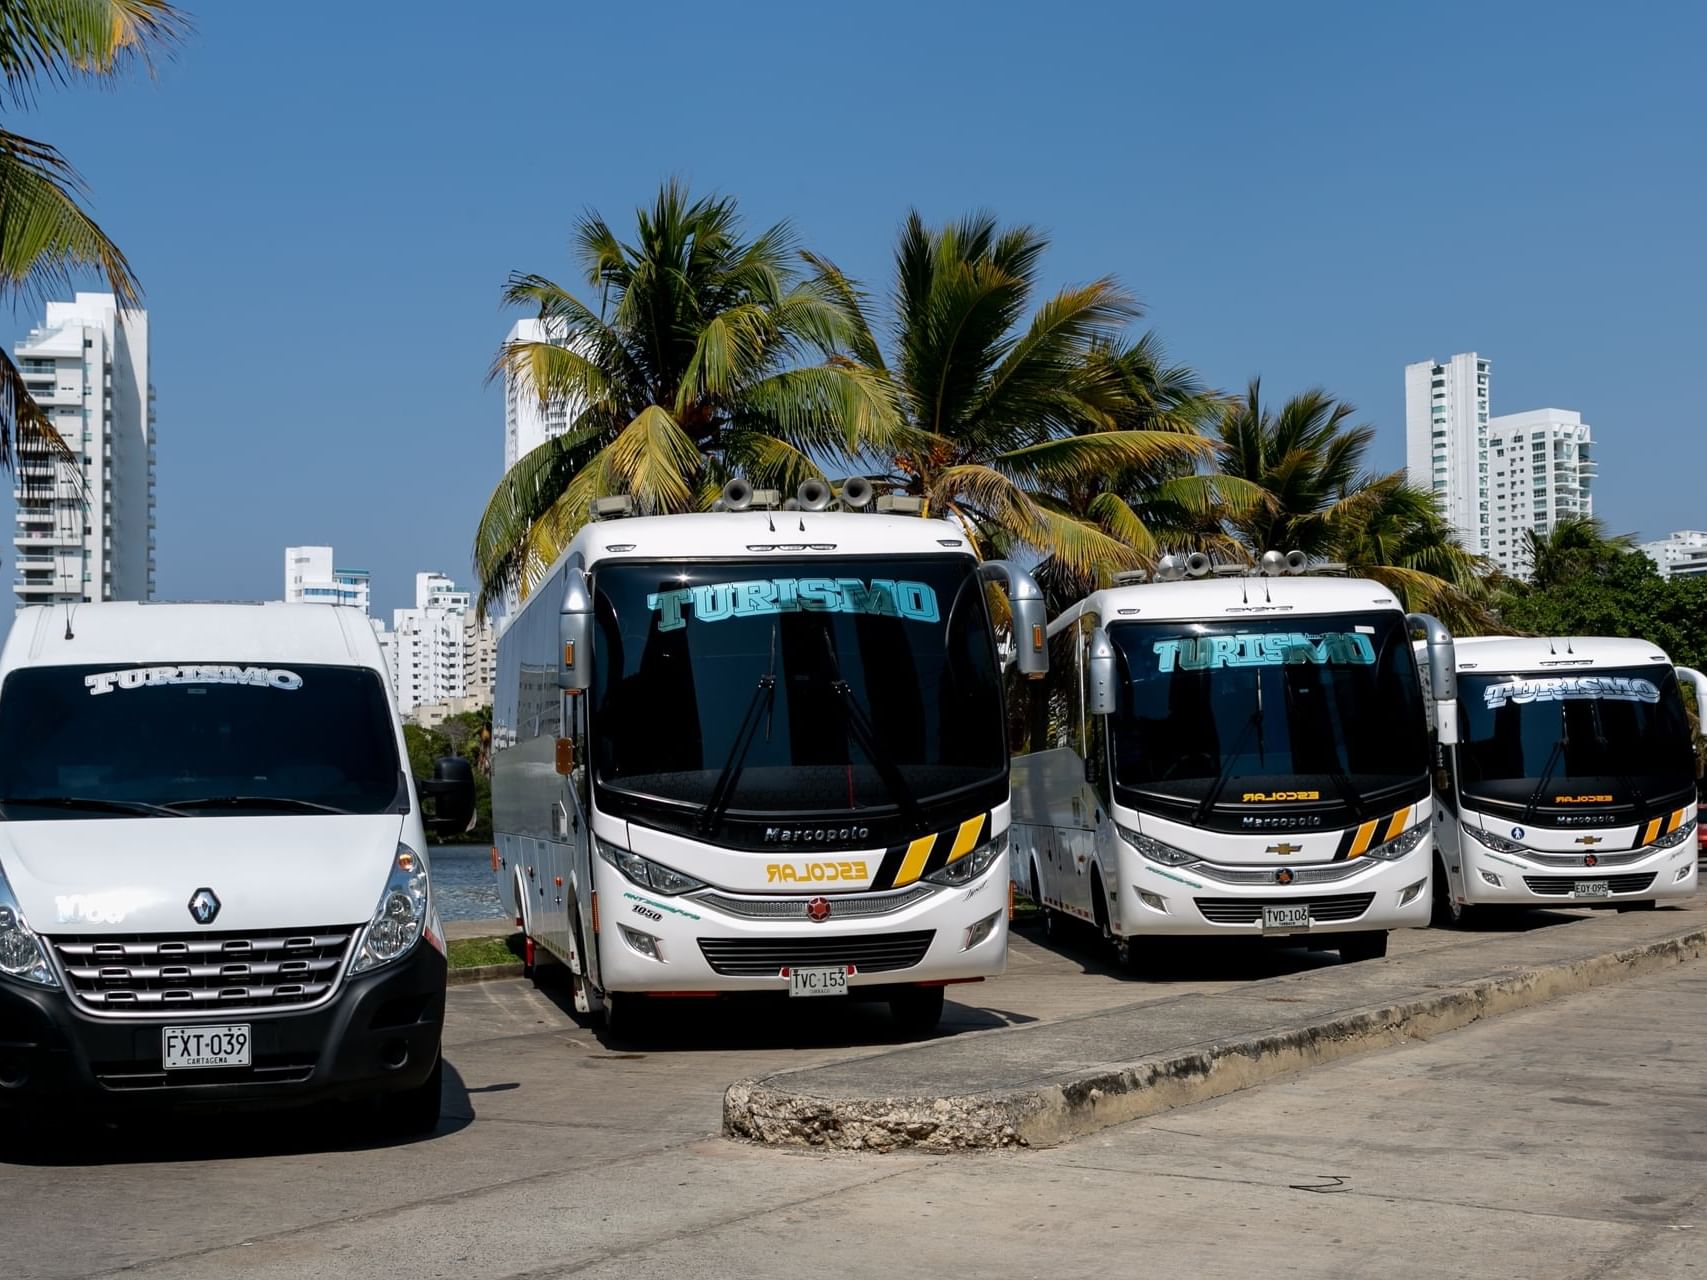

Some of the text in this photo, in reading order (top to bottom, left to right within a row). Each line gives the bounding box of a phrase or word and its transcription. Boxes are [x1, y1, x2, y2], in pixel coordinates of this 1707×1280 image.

[647, 578, 941, 632] TURISMO
[1153, 632, 1376, 673] TURISMO
[84, 665, 303, 695] TURISMO
[1483, 677, 1661, 709] TURISMO
[764, 826, 869, 842] Marcopolo
[631, 904, 663, 922] 1050
[187, 1057, 228, 1065] CARTAGENA
